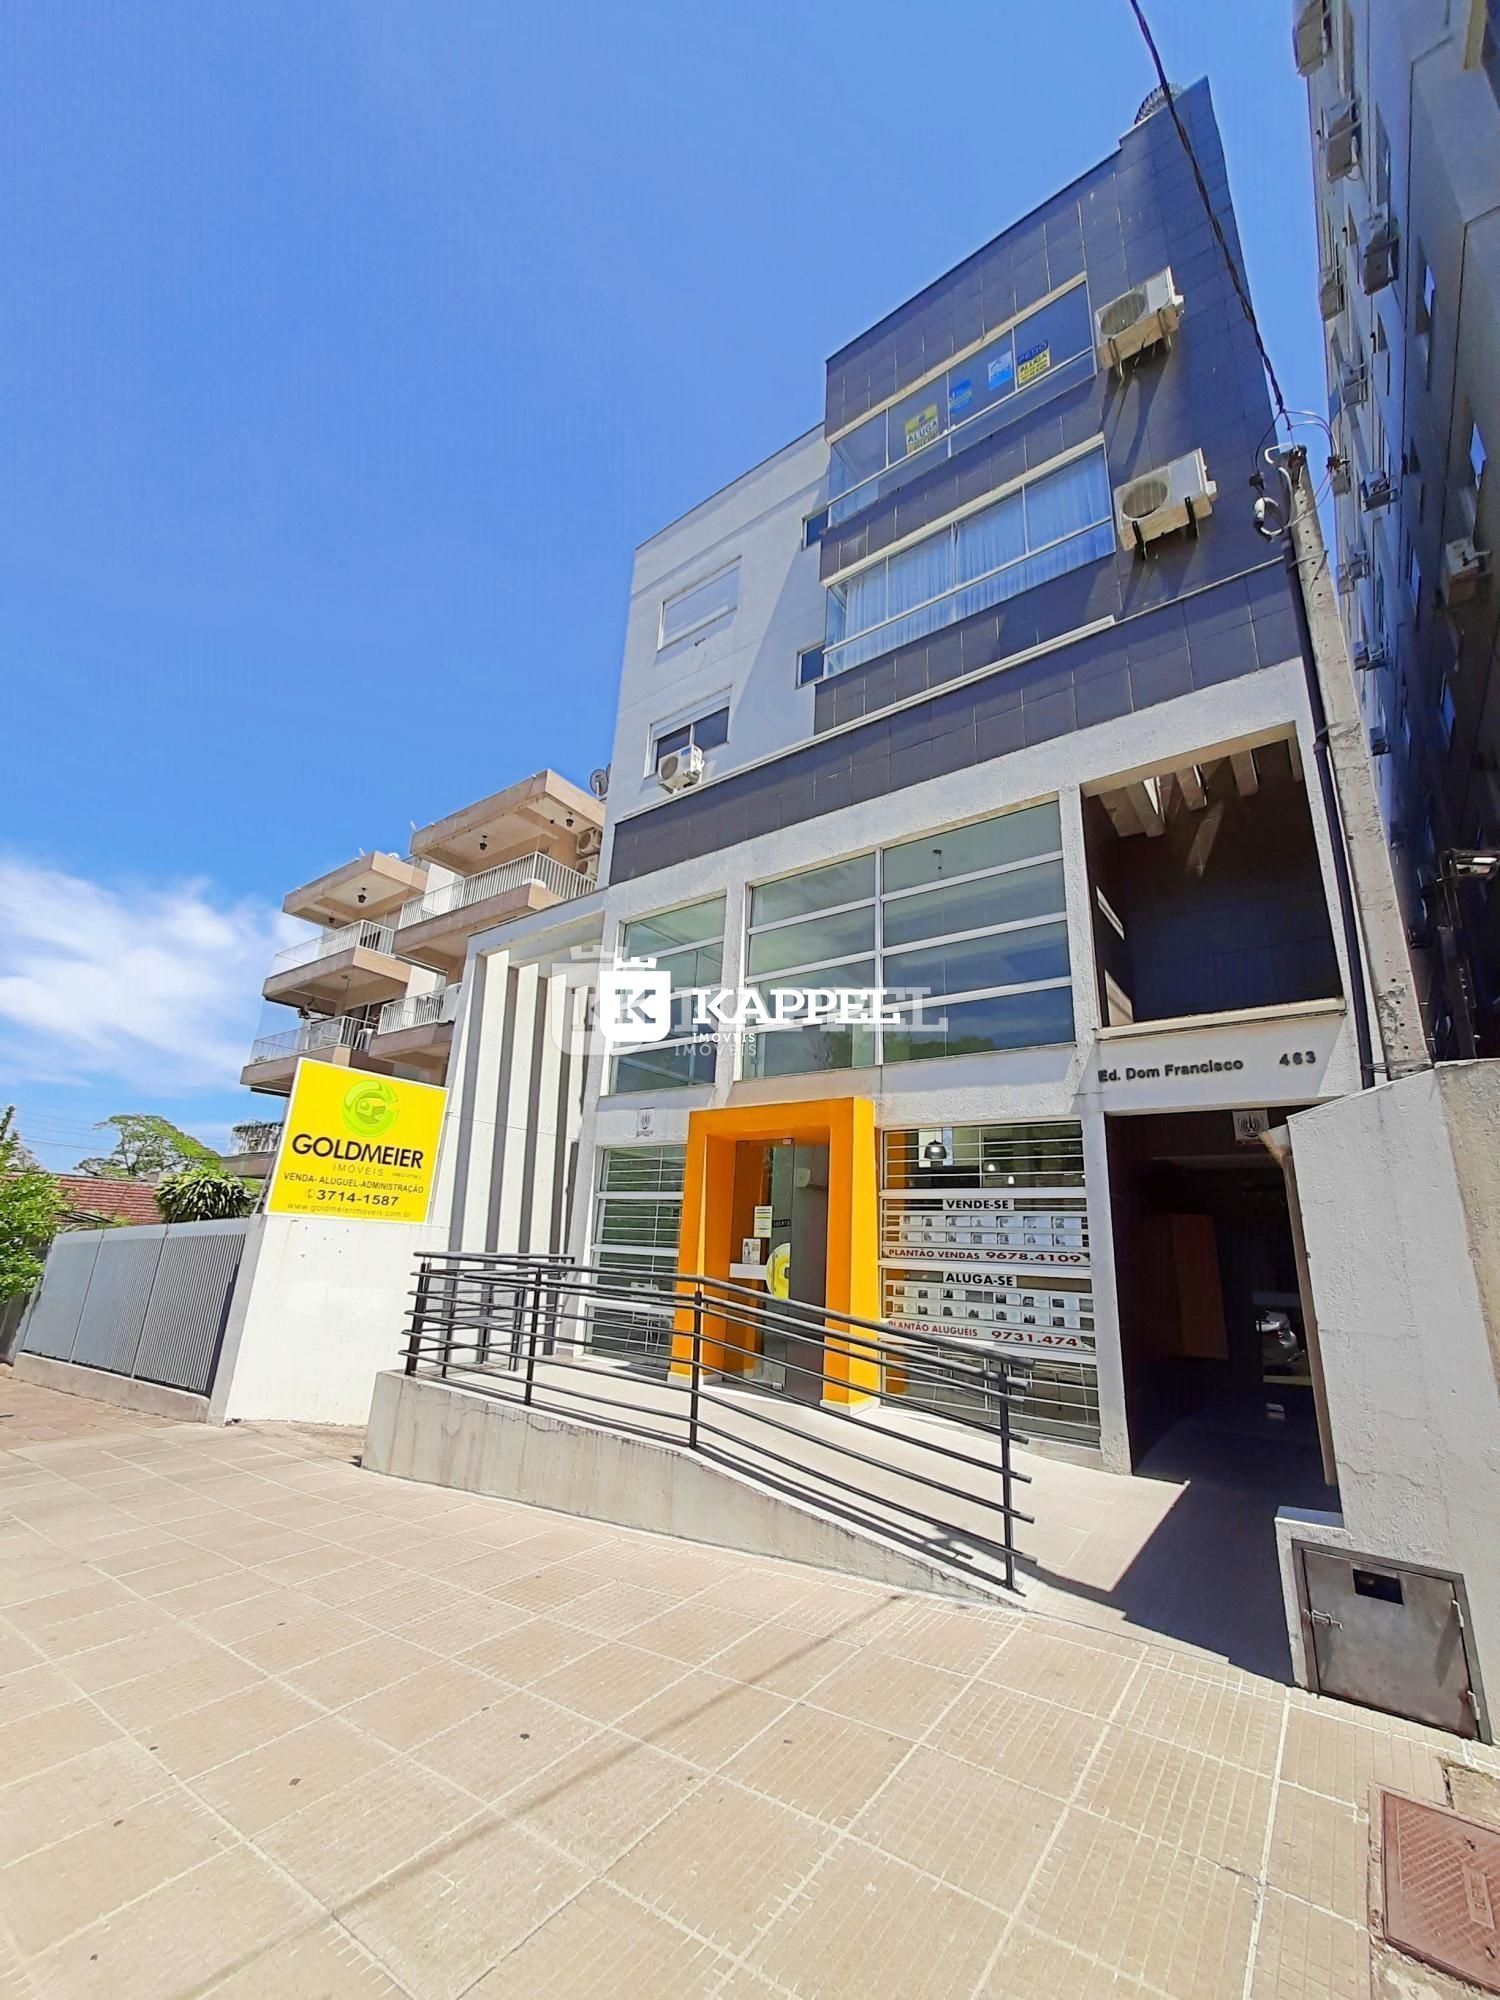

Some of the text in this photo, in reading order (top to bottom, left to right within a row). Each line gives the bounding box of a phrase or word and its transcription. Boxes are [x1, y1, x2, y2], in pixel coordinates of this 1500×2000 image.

[908, 420, 937, 443] ALUGA
[1279, 1051, 1316, 1067] 463
[1098, 1059, 1244, 1082] Ed. Dom Francisco
[292, 1133, 424, 1169] GOLDMEIER
[332, 1163, 384, 1177] IMÓVEIS
[316, 1189, 399, 1207] 3714-1587
[946, 1199, 1010, 1210] VENDE-SE
[888, 1248, 1081, 1263] PLANTÃO VENDAS 9678.4109
[945, 1272, 1014, 1287] ALUGA-SE
